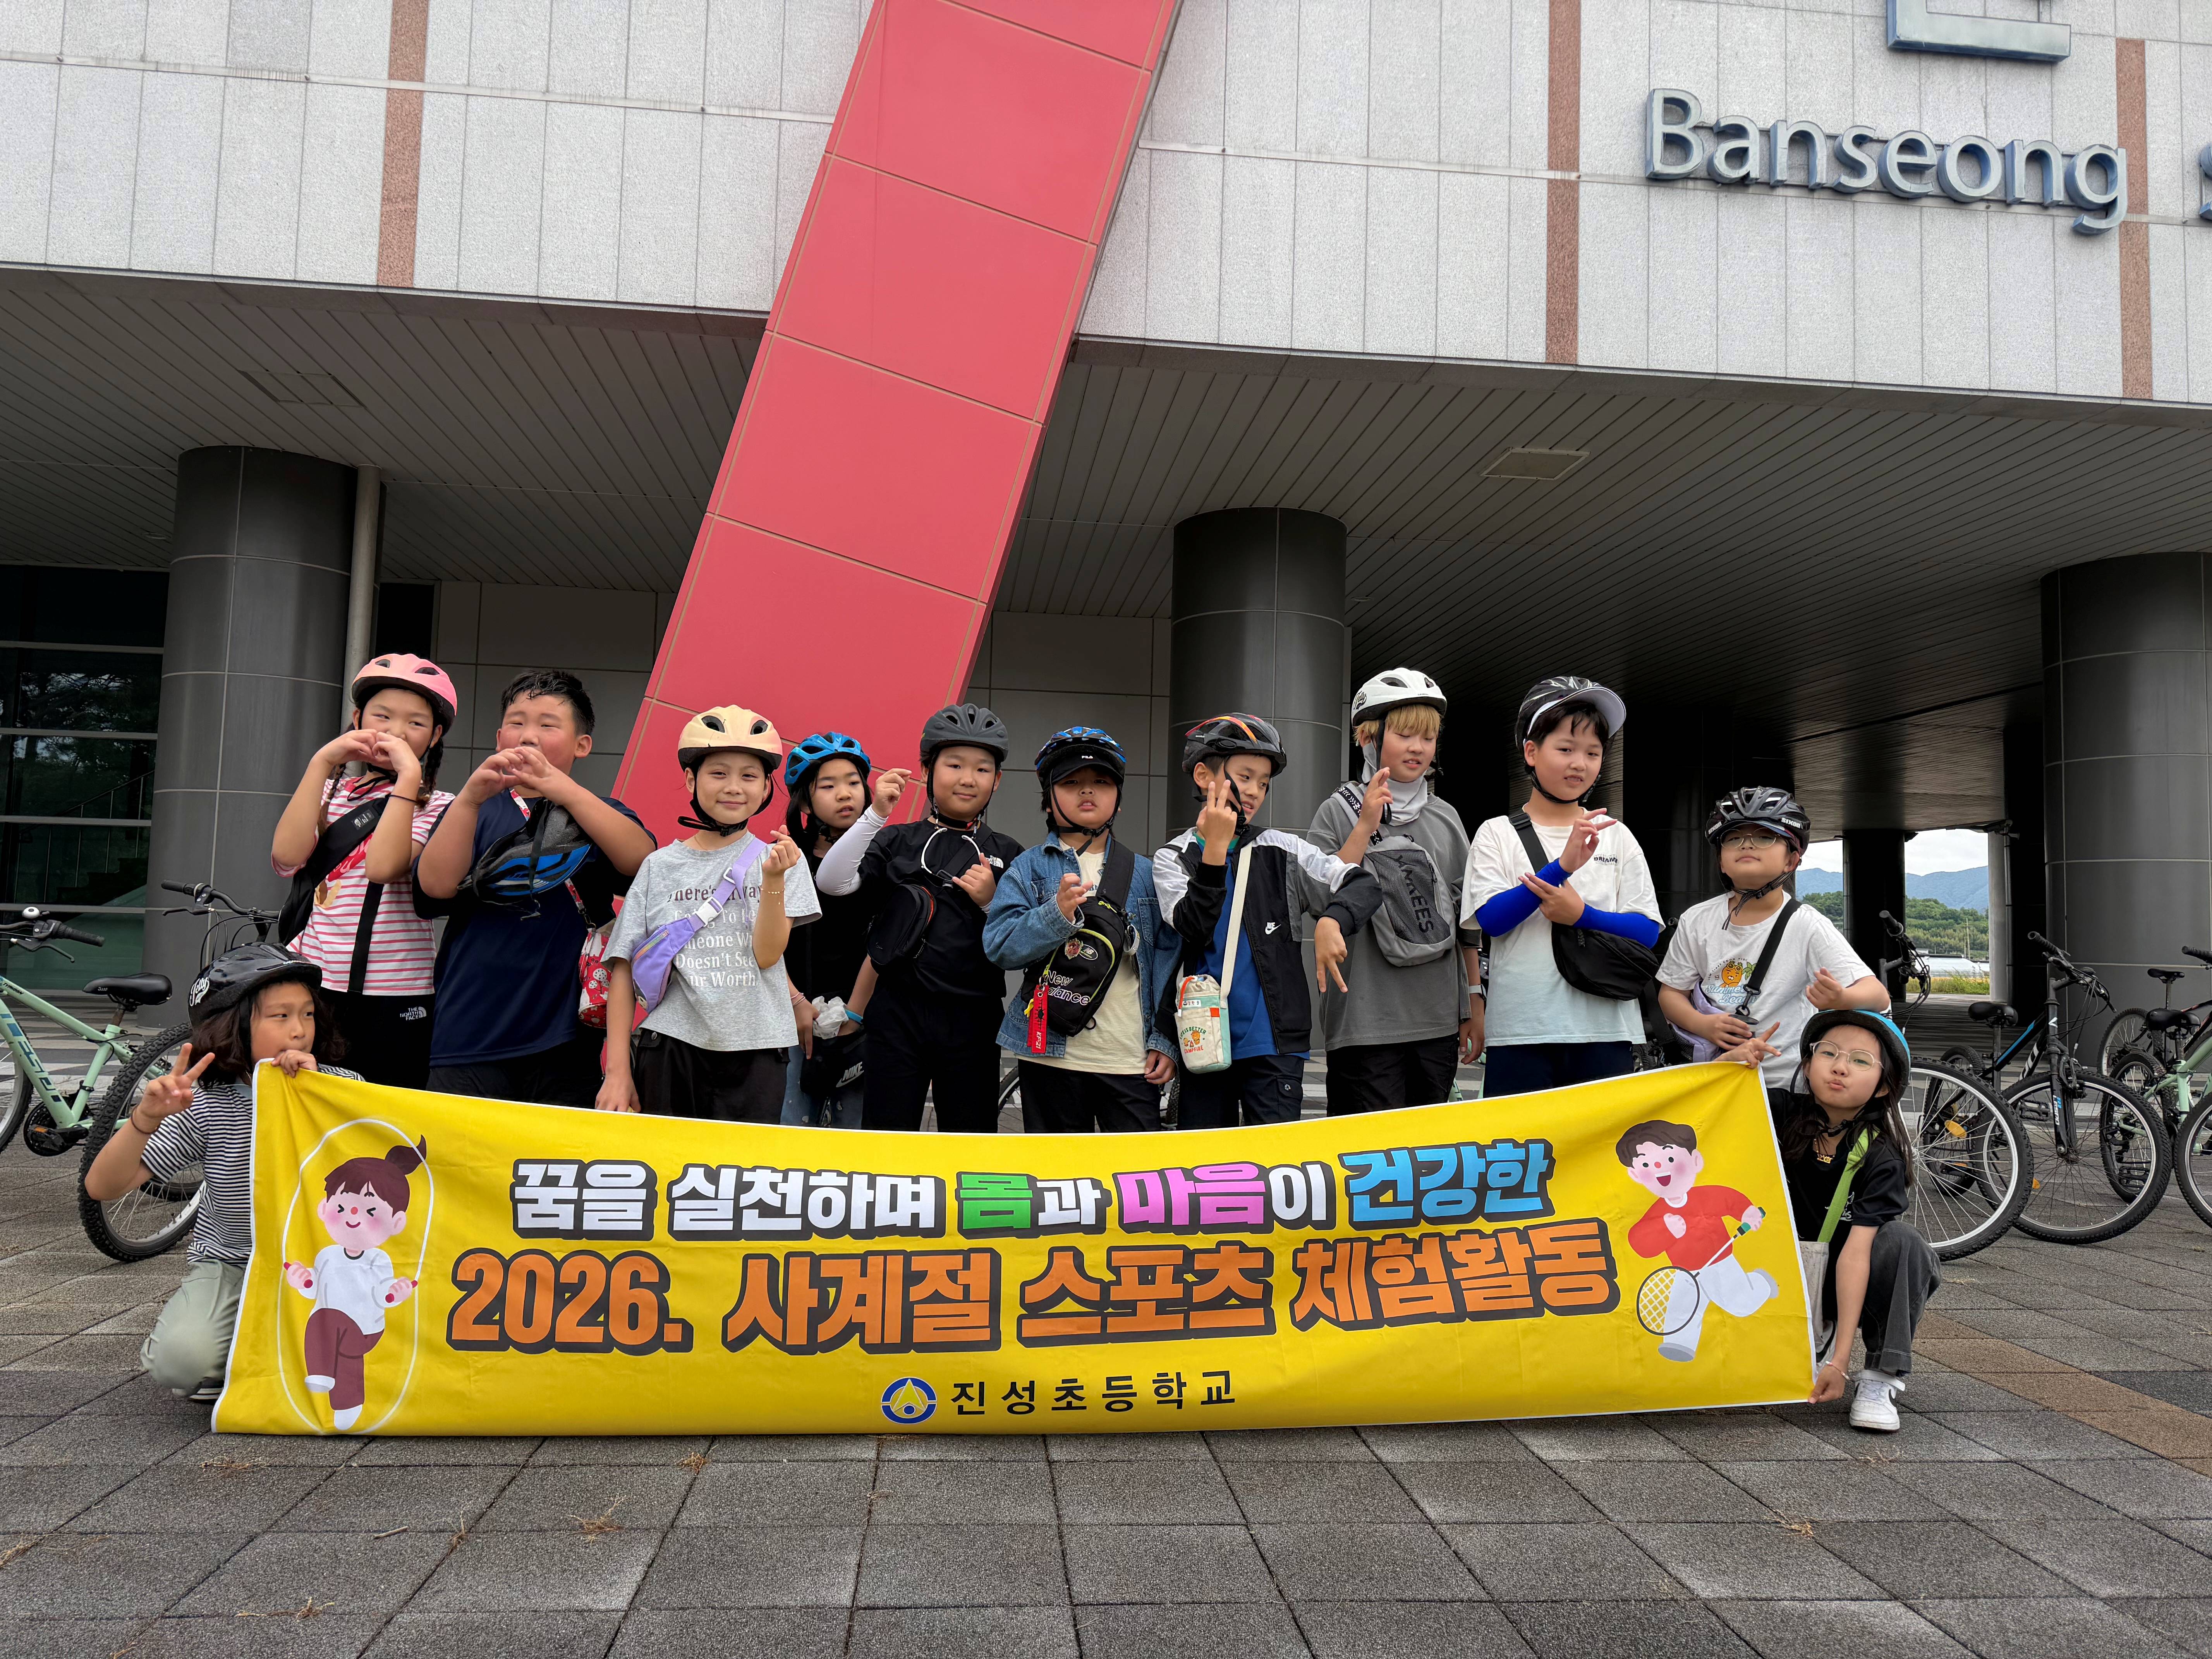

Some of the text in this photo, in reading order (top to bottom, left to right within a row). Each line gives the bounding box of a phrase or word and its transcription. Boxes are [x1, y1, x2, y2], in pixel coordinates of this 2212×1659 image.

[1645, 88, 2127, 235] Banseong
[676, 952, 732, 969] Doesn't
[1048, 970, 1073, 986] New
[1047, 986, 1091, 1006] alance
[1189, 1026, 1207, 1035] BETTER
[1184, 1045, 1204, 1054] CAMPFIRE
[512, 1140, 1552, 1236] 꿈을 실천하며 몸과 마음이 건강한
[448, 1221, 1613, 1349] 2026. 사계절 스포츠 체험활동
